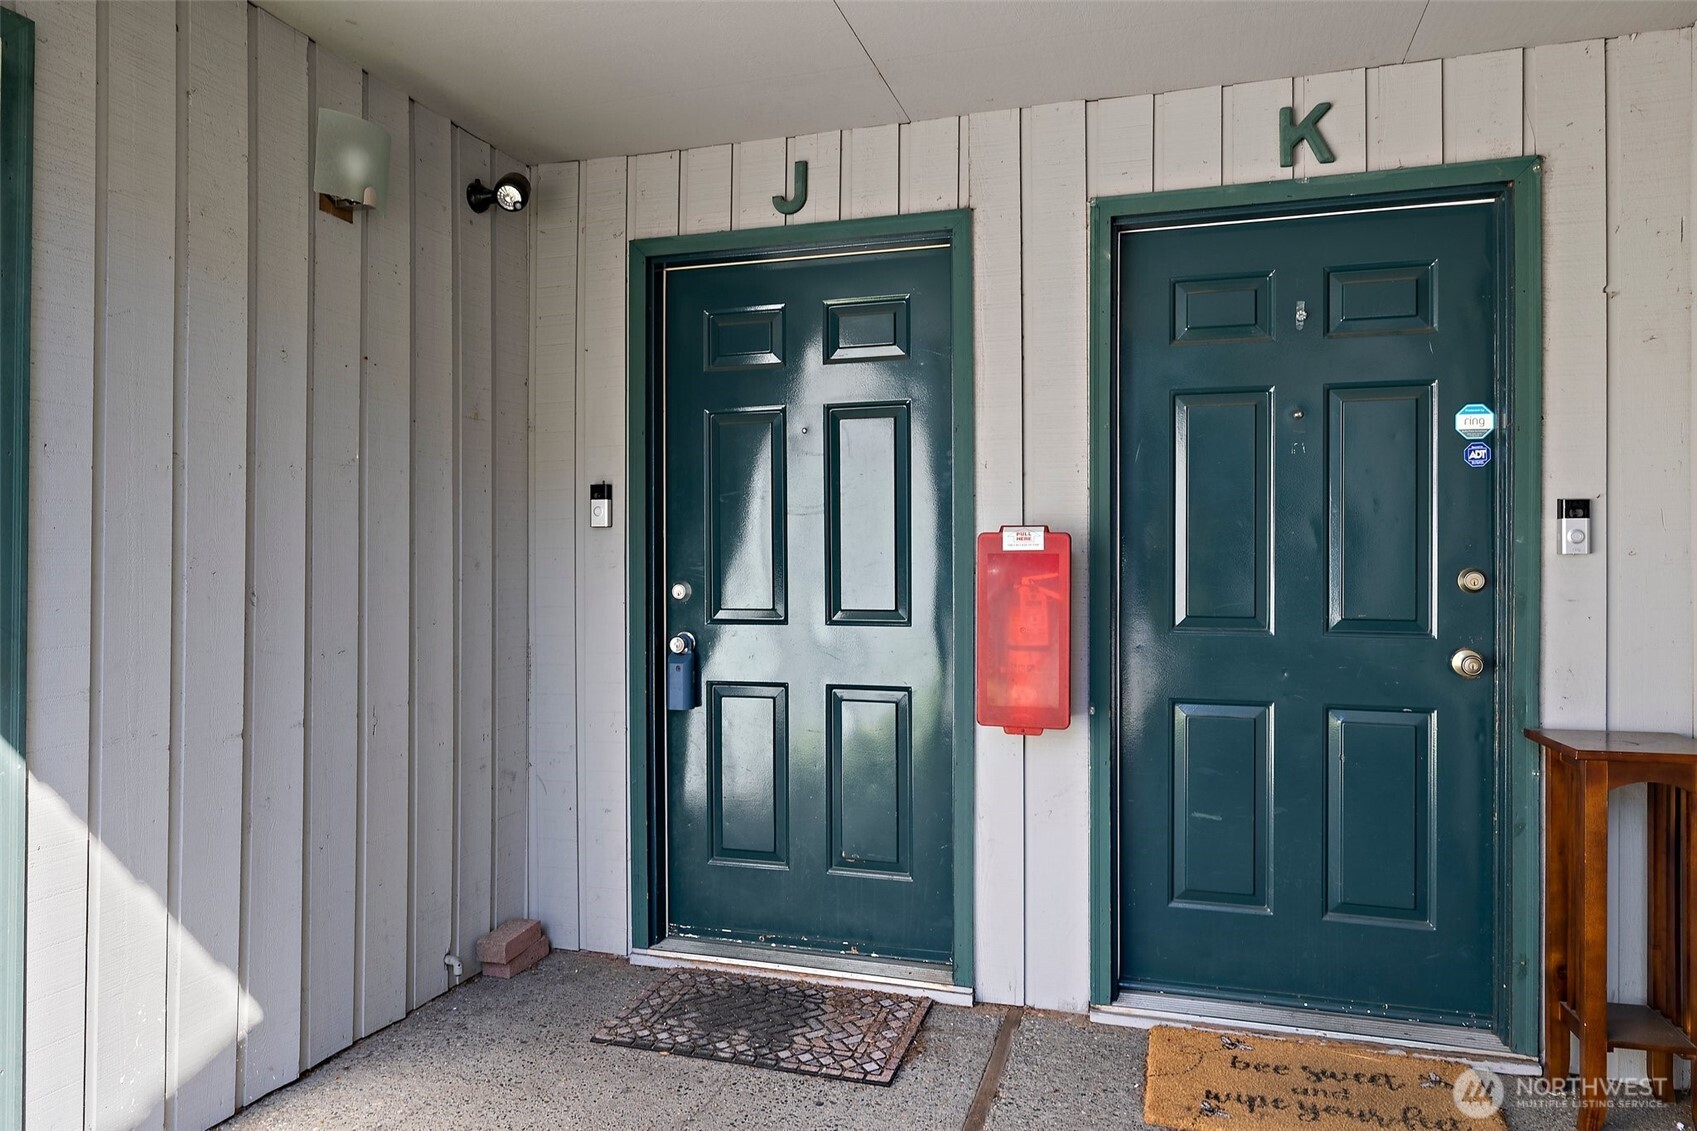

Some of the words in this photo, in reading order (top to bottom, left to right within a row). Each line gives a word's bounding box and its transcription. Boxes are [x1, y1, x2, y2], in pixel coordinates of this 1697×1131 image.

[1279, 101, 1336, 168] K
[772, 160, 808, 215] J
[1464, 416, 1485, 427] ring
[1469, 450, 1487, 459] ADT
[1230, 1055, 1290, 1076] bee
